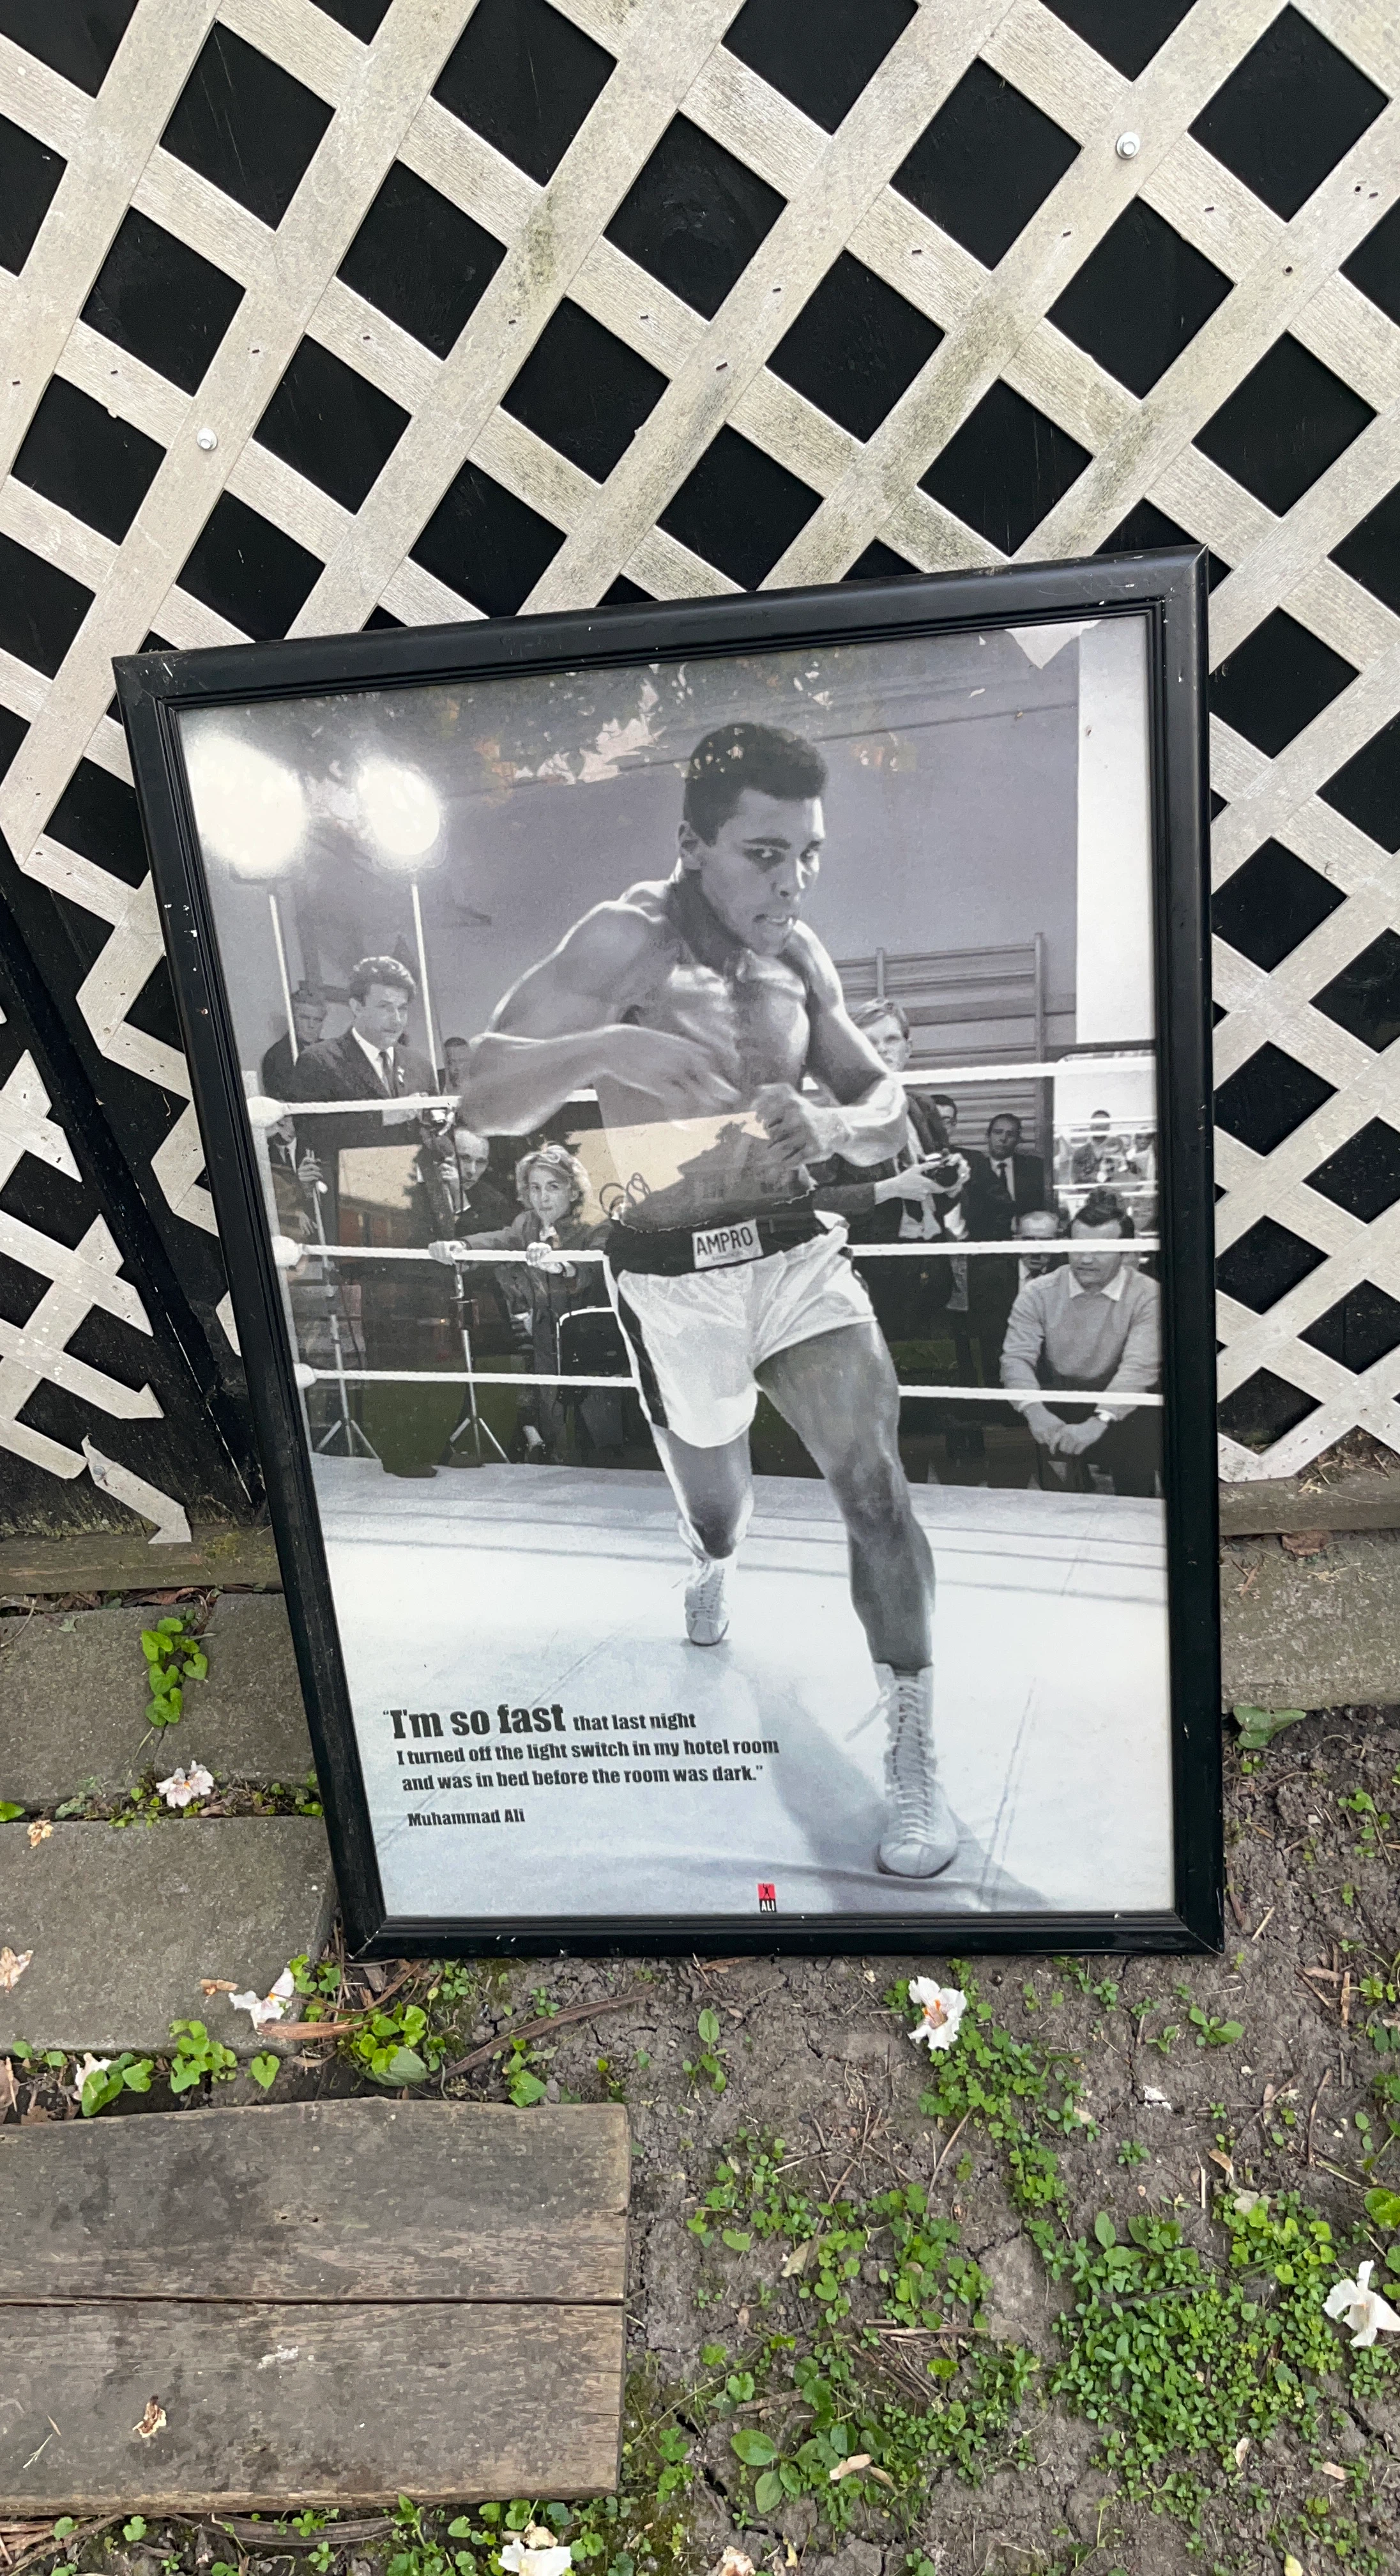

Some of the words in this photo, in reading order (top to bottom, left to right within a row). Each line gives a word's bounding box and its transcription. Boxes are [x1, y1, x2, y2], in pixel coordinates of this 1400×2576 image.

[696, 1227, 753, 1255] AMPRO
[450, 1710, 491, 1736] so
[497, 1704, 567, 1734] fast
[572, 1715, 609, 1731] that
[612, 1715, 646, 1730] last
[649, 1713, 696, 1730] night
[396, 1751, 405, 1765] I
[407, 1747, 466, 1765] turned
[469, 1745, 492, 1761] off
[494, 1745, 524, 1760] the
[526, 1743, 568, 1761] light
[571, 1741, 629, 1758] switch
[632, 1742, 651, 1756] in
[653, 1743, 679, 1757] my
[683, 1739, 729, 1755] hotel
[733, 1740, 780, 1754] room
[402, 1775, 435, 1791] and
[437, 1775, 473, 1789] was
[476, 1772, 494, 1788] in
[496, 1771, 529, 1787] bed
[531, 1770, 588, 1786] before
[591, 1768, 620, 1784] the
[623, 1770, 670, 1783] room
[673, 1768, 708, 1782] was
[407, 1809, 501, 1827] Muhammad
[505, 1809, 526, 1823] Ali
[761, 1899, 775, 1912] ALI
